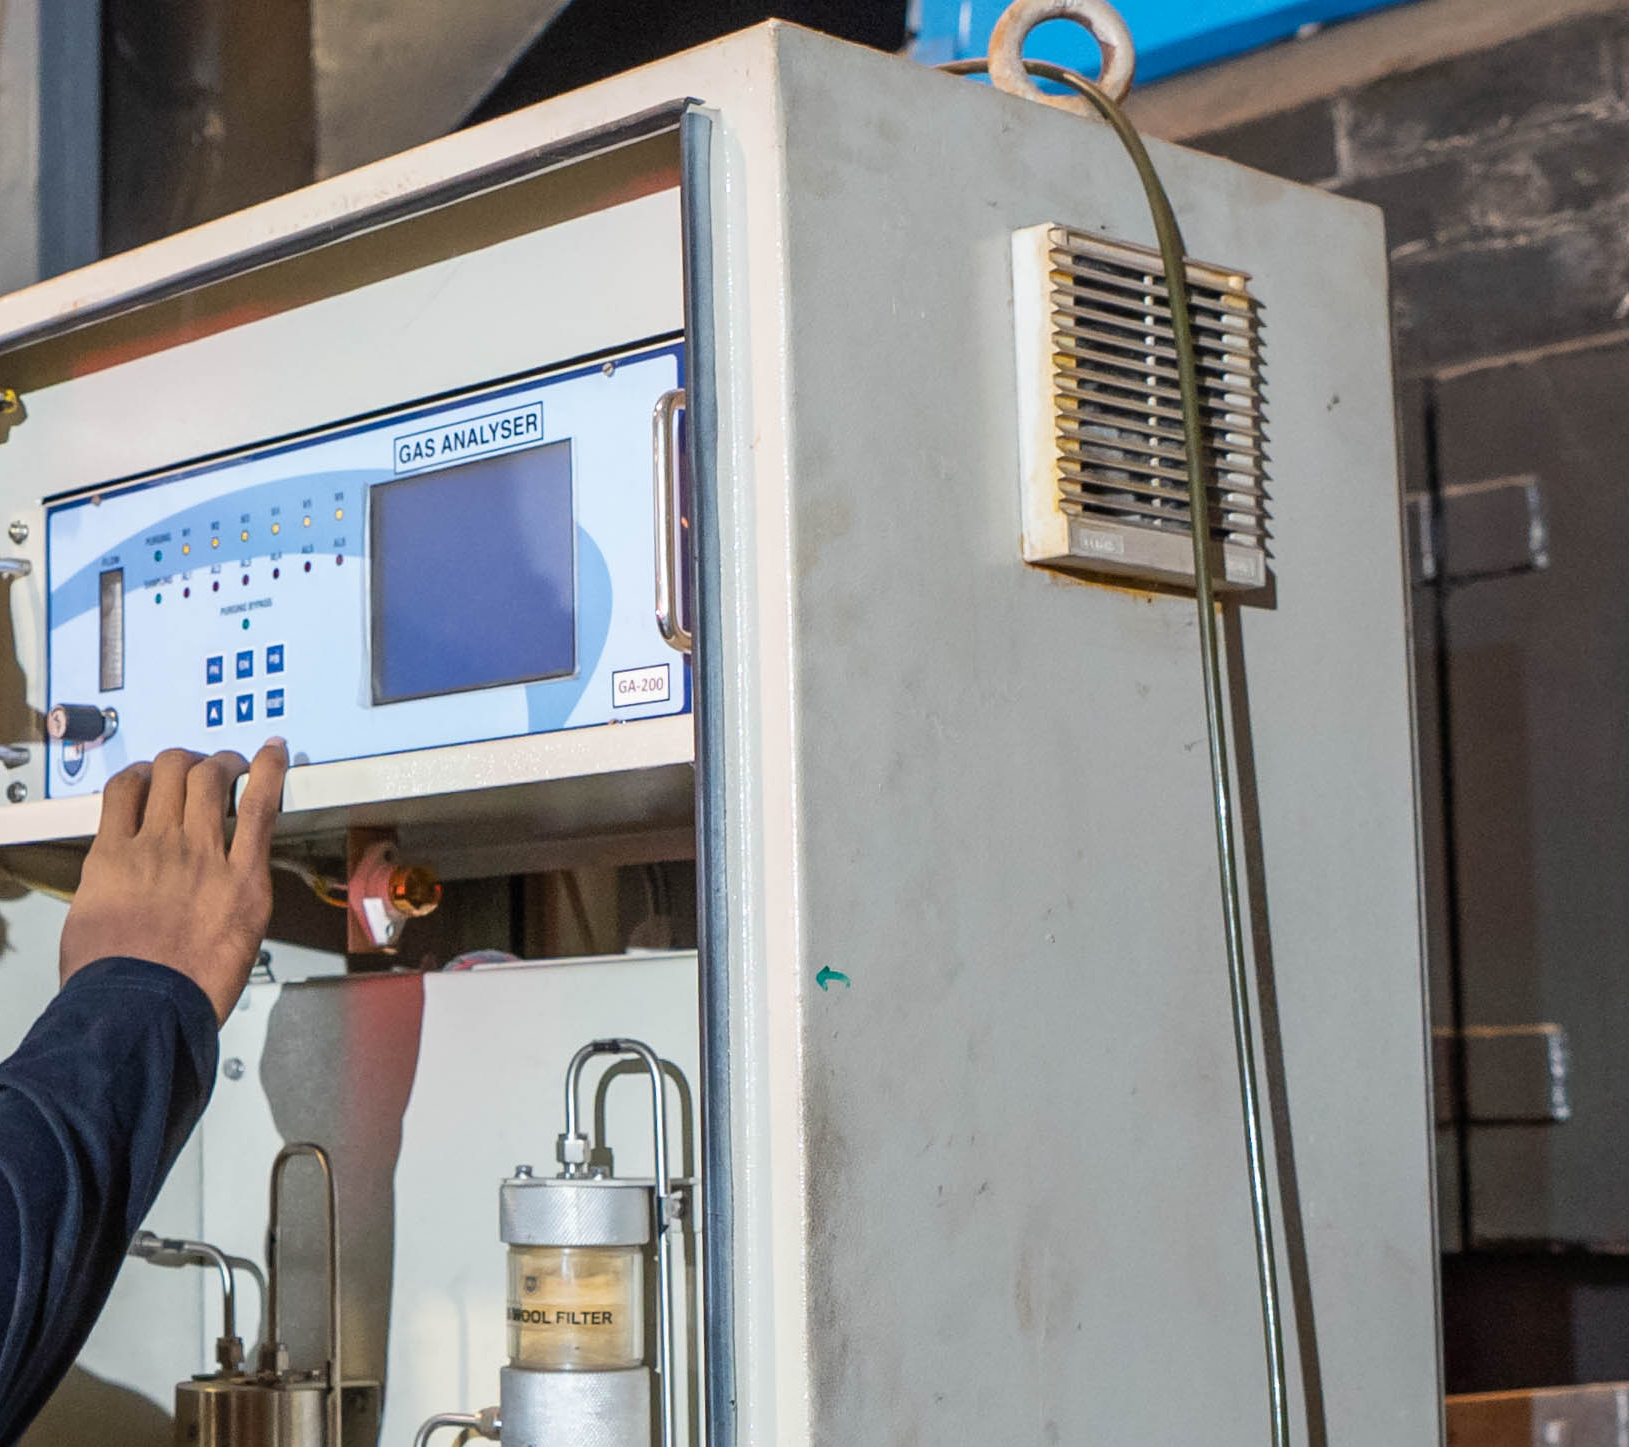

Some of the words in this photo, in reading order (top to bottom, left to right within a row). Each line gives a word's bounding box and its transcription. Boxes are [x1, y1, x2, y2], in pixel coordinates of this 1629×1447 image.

[398, 437, 436, 464] GAS
[440, 412, 539, 455] ANALYSER
[618, 676, 664, 694] GA-200
[555, 1310, 613, 1325] FILTER
